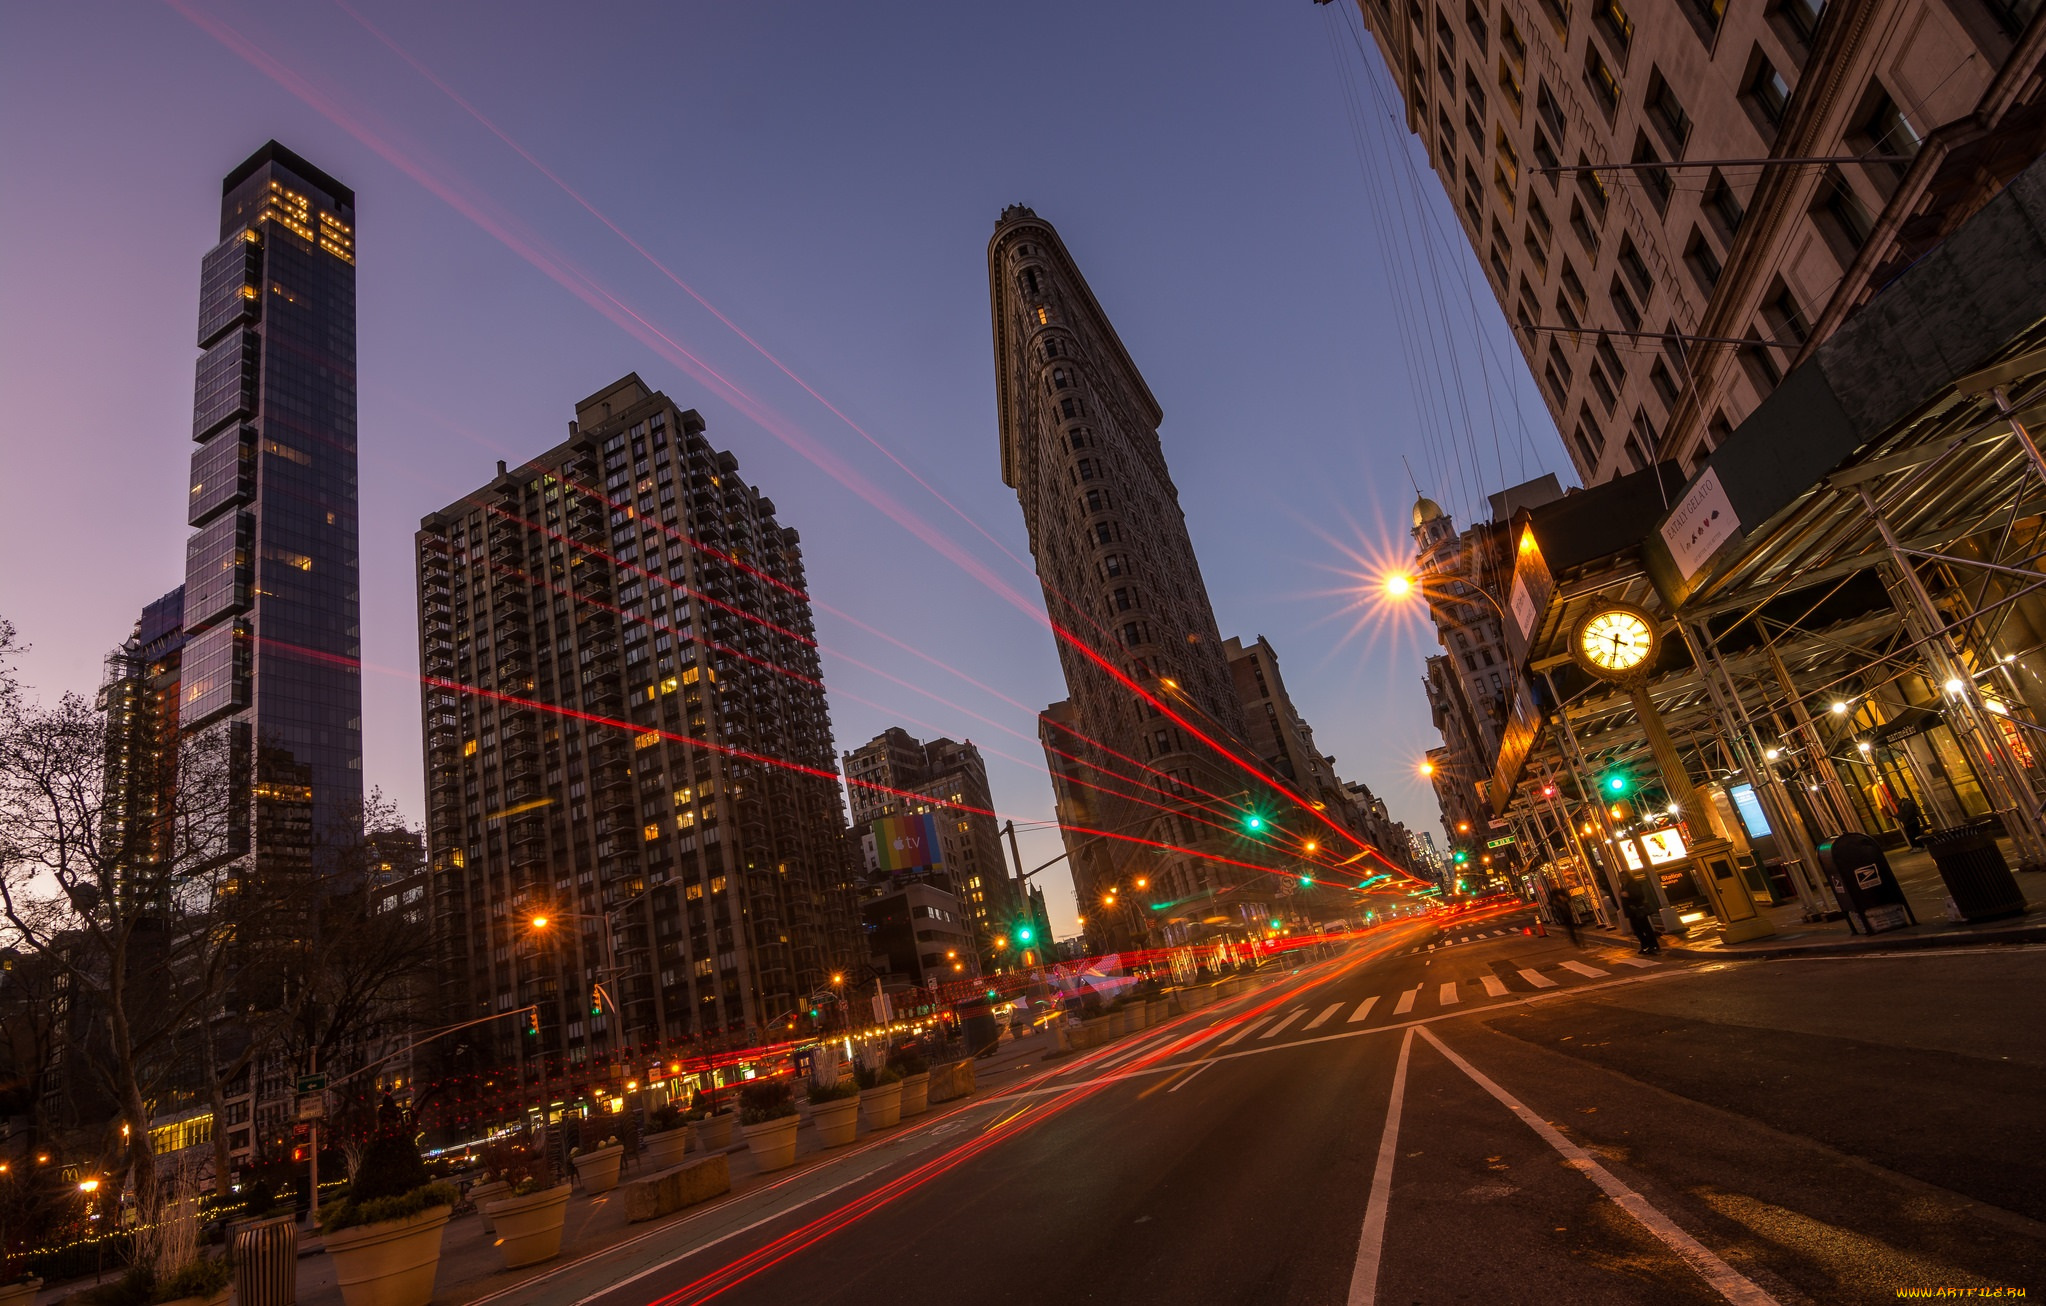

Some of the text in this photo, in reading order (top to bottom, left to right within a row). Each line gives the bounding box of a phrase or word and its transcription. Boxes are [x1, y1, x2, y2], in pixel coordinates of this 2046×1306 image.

[1666, 479, 1714, 540] EATALY GELATO
[905, 836, 920, 849] tv
[1660, 872, 1683, 881] Station
